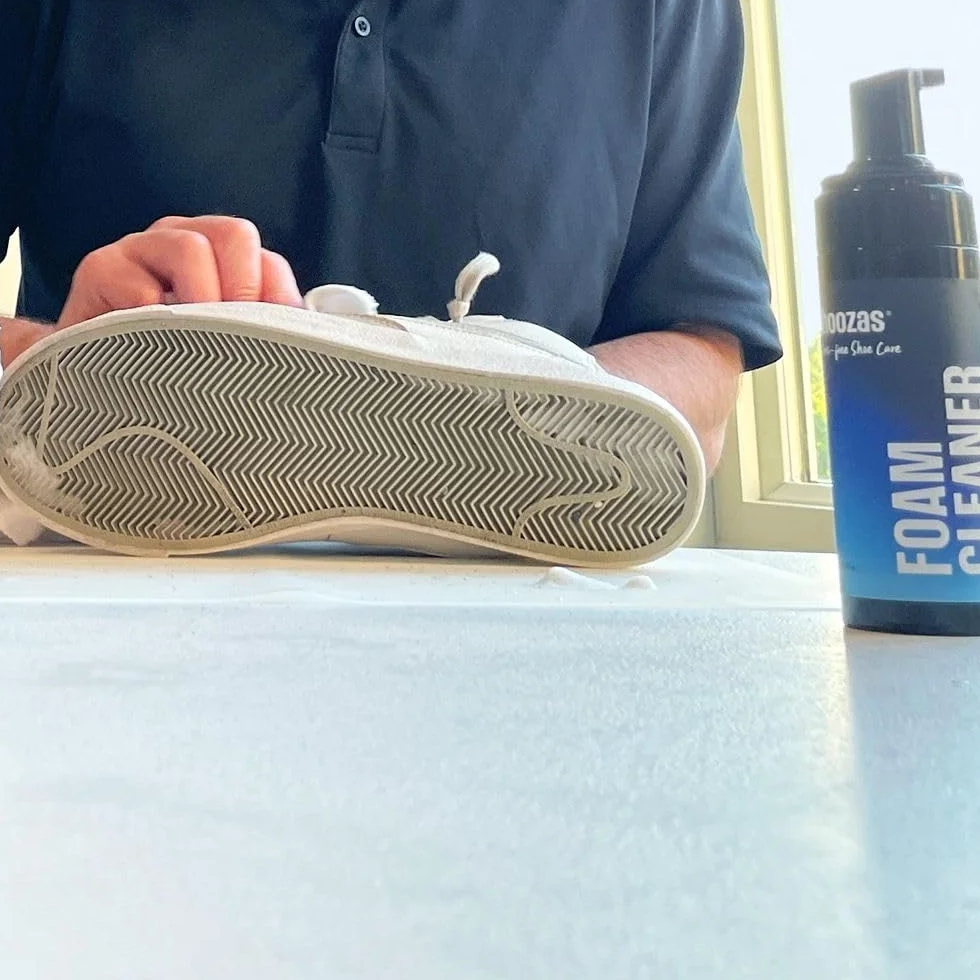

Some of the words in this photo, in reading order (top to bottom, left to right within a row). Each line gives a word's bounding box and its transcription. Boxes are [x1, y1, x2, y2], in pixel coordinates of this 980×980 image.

[823, 310, 886, 334] oozas
[850, 340, 873, 356] Shoe
[876, 341, 902, 356] Care
[887, 442, 953, 575] FOAM
